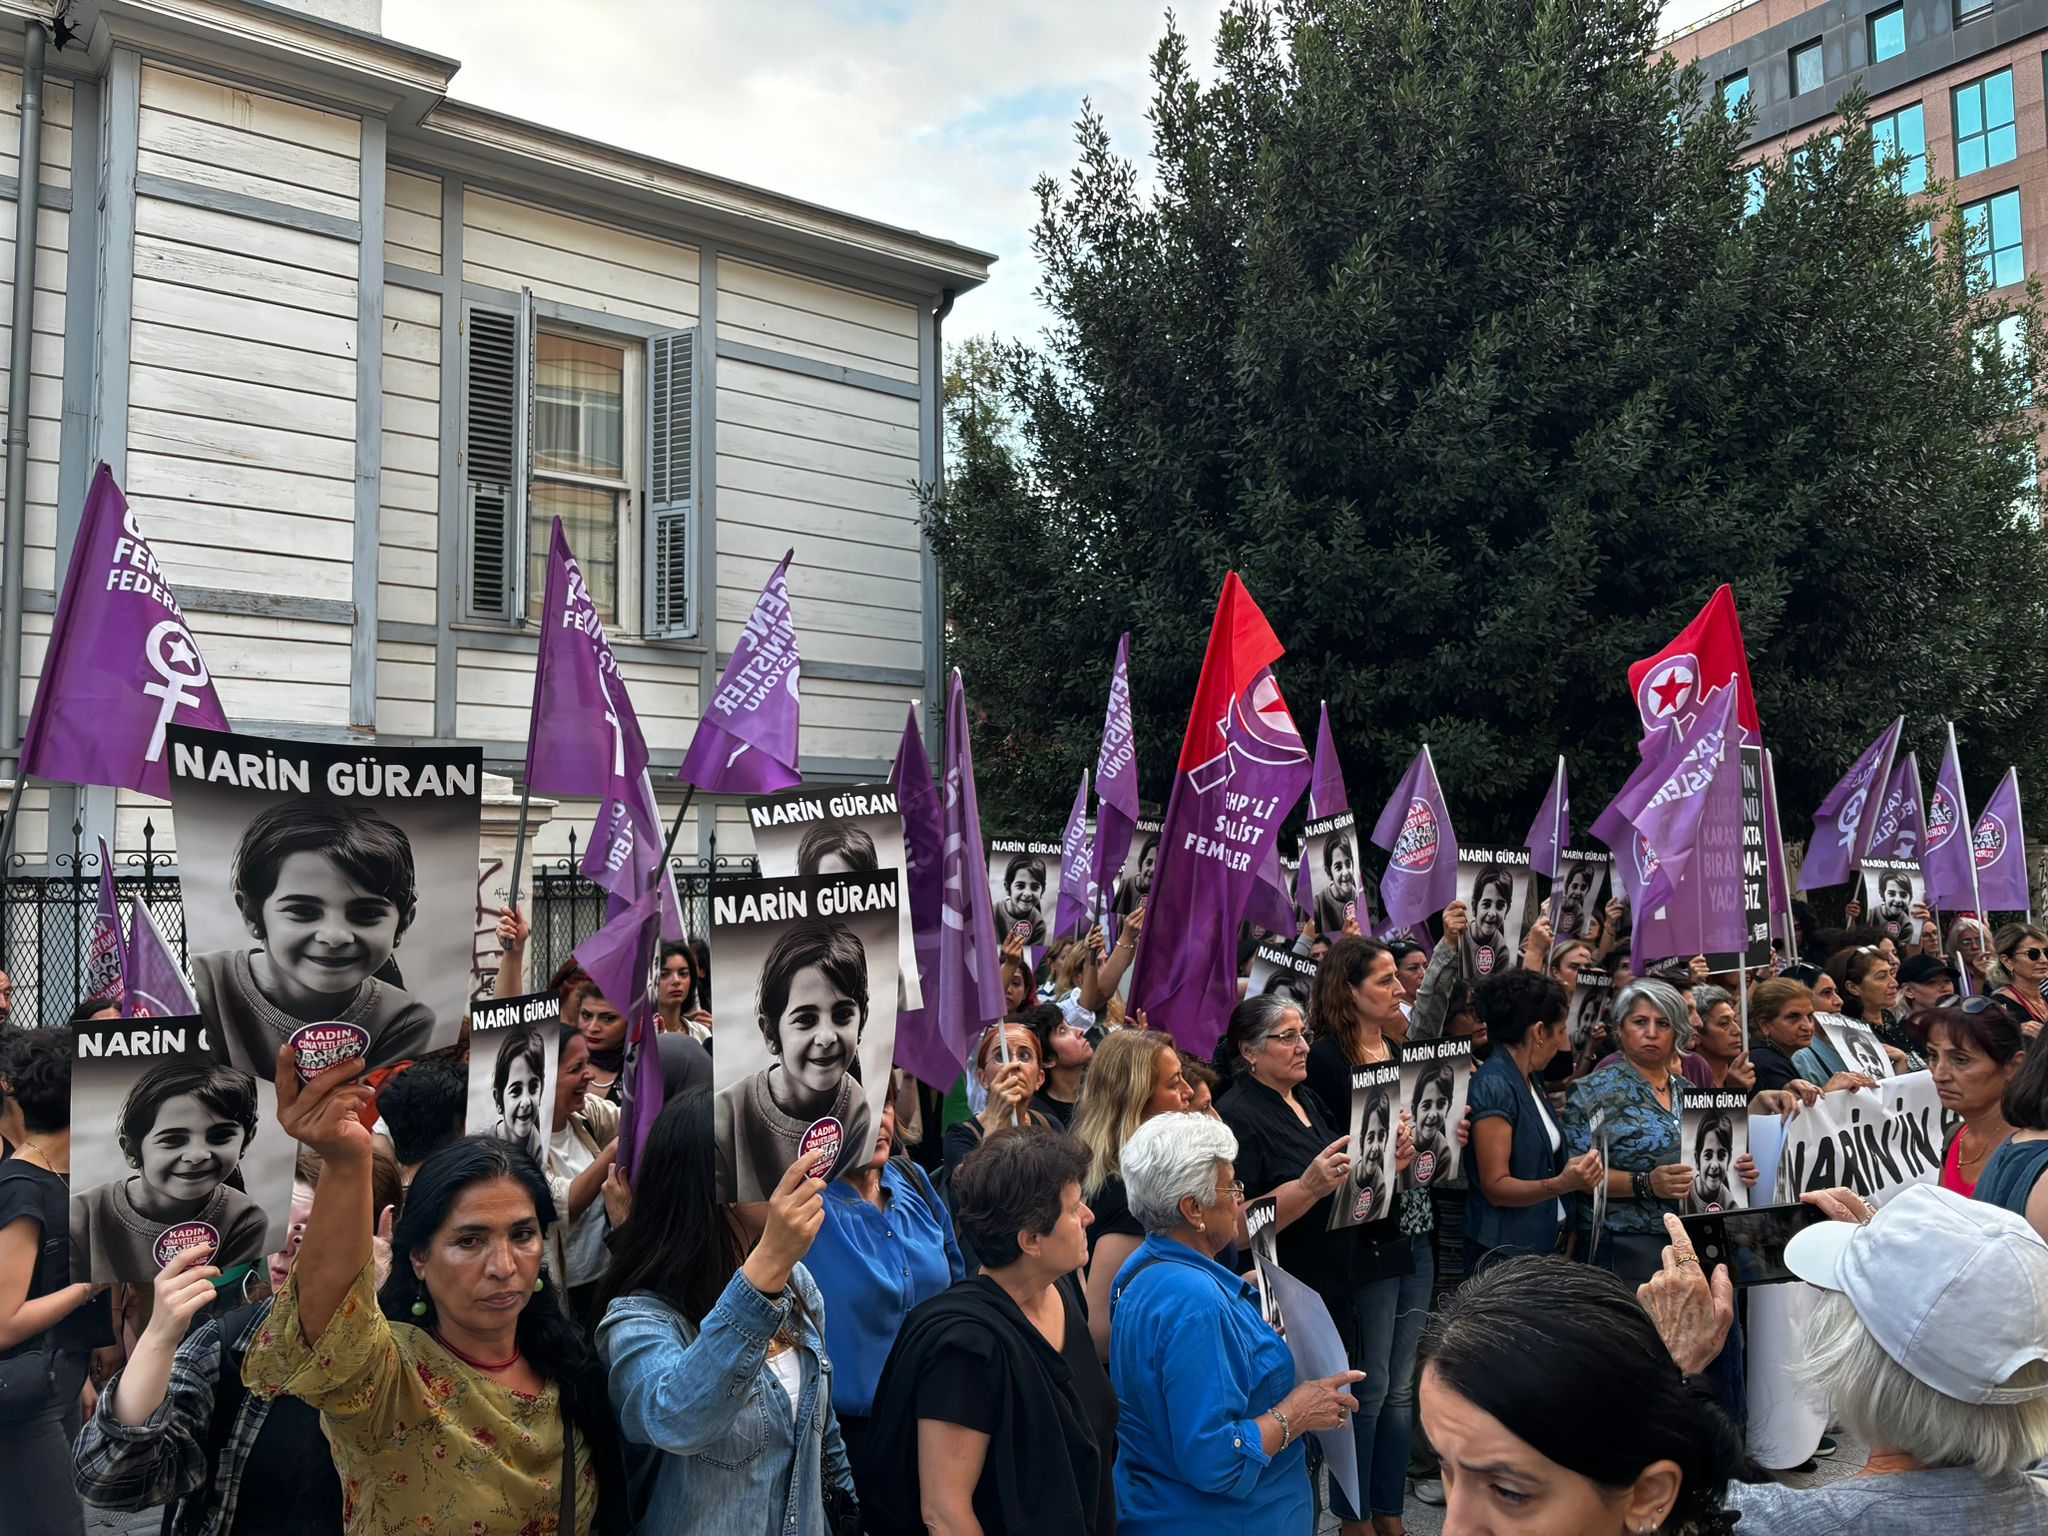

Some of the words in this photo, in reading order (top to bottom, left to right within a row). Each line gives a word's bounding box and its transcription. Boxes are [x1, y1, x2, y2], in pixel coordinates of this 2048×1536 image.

[106, 569, 187, 624] FEDERA
[174, 742, 310, 793] NARİN
[327, 756, 475, 797] GÜRAN
[751, 797, 824, 828] NARİN
[829, 793, 897, 818] GÜRAN
[1304, 820, 1334, 838] NARİN
[1333, 812, 1354, 830] GÜRAN
[992, 840, 1025, 853] NARİN
[1028, 841, 1062, 855] GÜRAN
[1459, 848, 1493, 863] NARİN
[1495, 849, 1530, 865] GÜRAN
[1561, 848, 1584, 861] NARİN
[1584, 850, 1608, 862] GÜRAN
[1860, 859, 1889, 869] NARİN
[714, 886, 808, 926] NARİN
[816, 881, 896, 916] GÜRAN
[1257, 945, 1293, 968] NARİN
[1294, 960, 1317, 977] GÜR
[1576, 973, 1597, 986] NARİN
[472, 1004, 520, 1031] NARİN
[523, 998, 560, 1023] GÜRAN
[78, 1025, 186, 1058] NARİN
[298, 1034, 358, 1050] CİNAYETLERİNİ
[305, 1028, 352, 1040] KADIN
[1402, 1045, 1435, 1063] NARİN
[1437, 1040, 1472, 1058] GÜRAN
[1352, 1068, 1376, 1090] NARİN
[1376, 1065, 1400, 1085] GÜRAN
[1684, 1092, 1714, 1109] NARİN
[1716, 1091, 1747, 1108] GÜRAN
[810, 1123, 837, 1139] KADIN
[169, 1226, 205, 1238] KADIN
